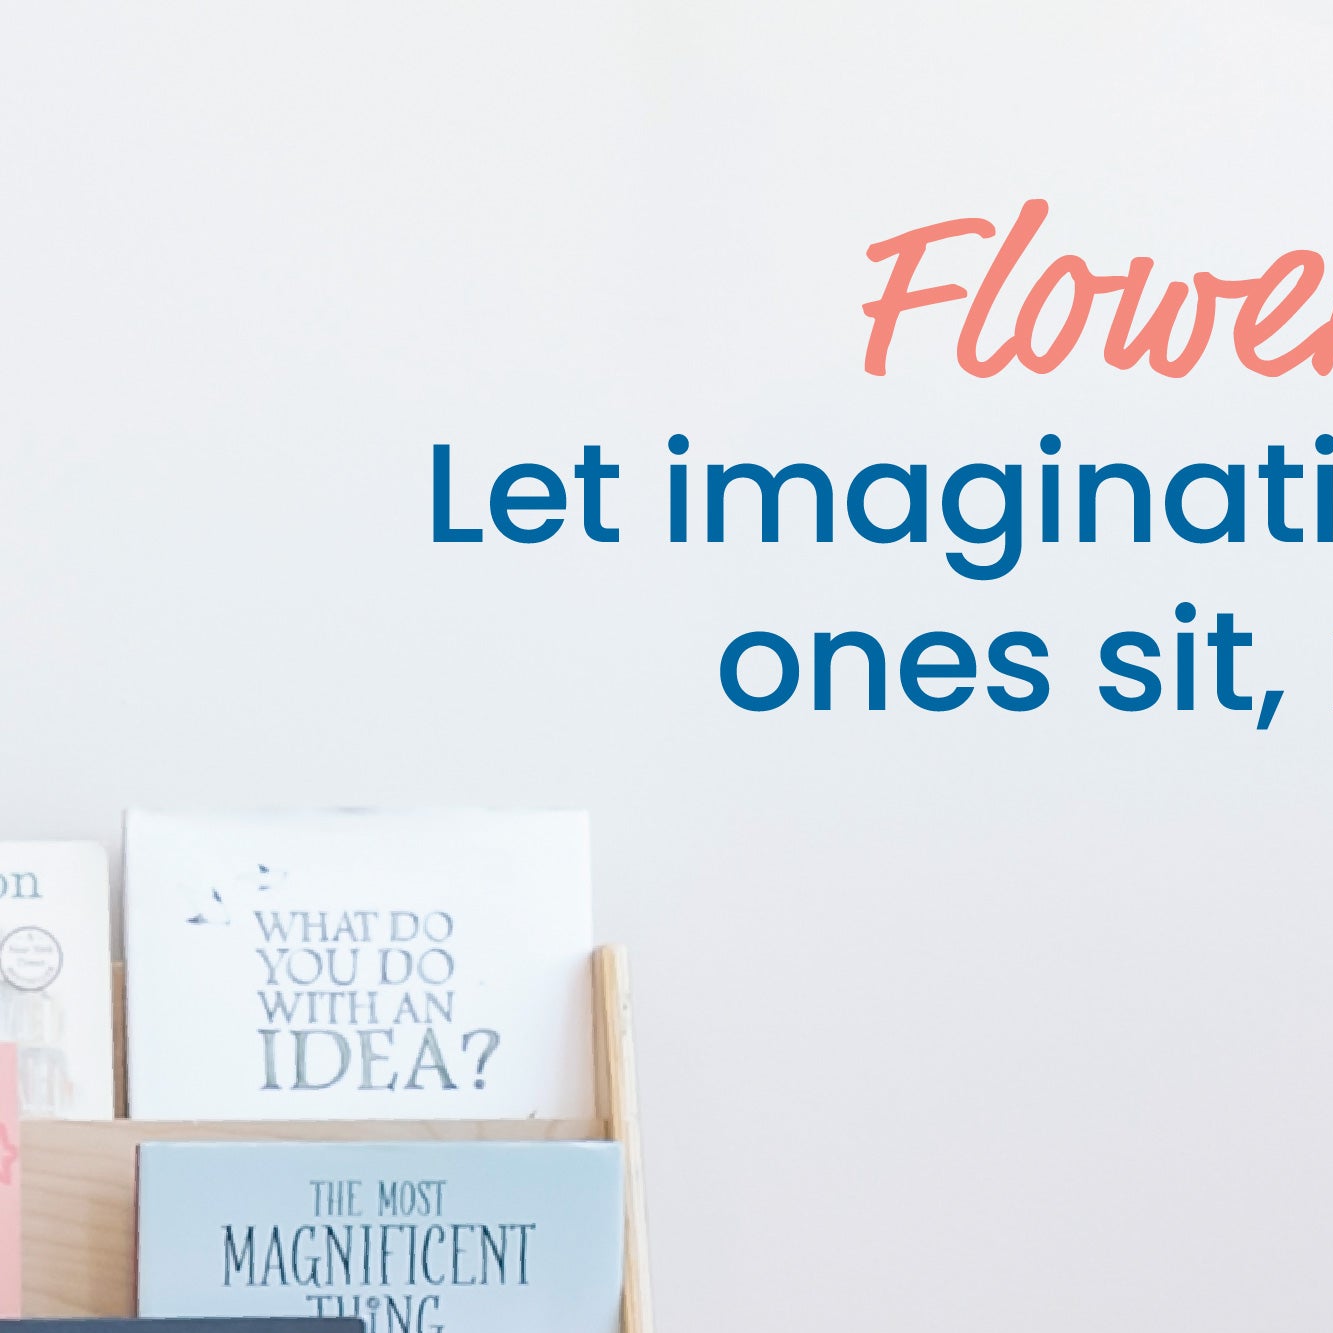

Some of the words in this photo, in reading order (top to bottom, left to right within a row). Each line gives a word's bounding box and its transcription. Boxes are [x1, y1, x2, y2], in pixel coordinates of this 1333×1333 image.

[254, 910, 379, 943] WHAT
[390, 910, 455, 943] DO
[255, 947, 360, 986] YOU
[378, 947, 455, 986] DO
[257, 991, 379, 1025] WITH
[392, 991, 455, 1025] AN
[257, 1027, 501, 1091] IDEA?
[309, 1180, 362, 1217] THE
[378, 1180, 446, 1217] MOST
[221, 1222, 537, 1288] MAGNIFICENT
